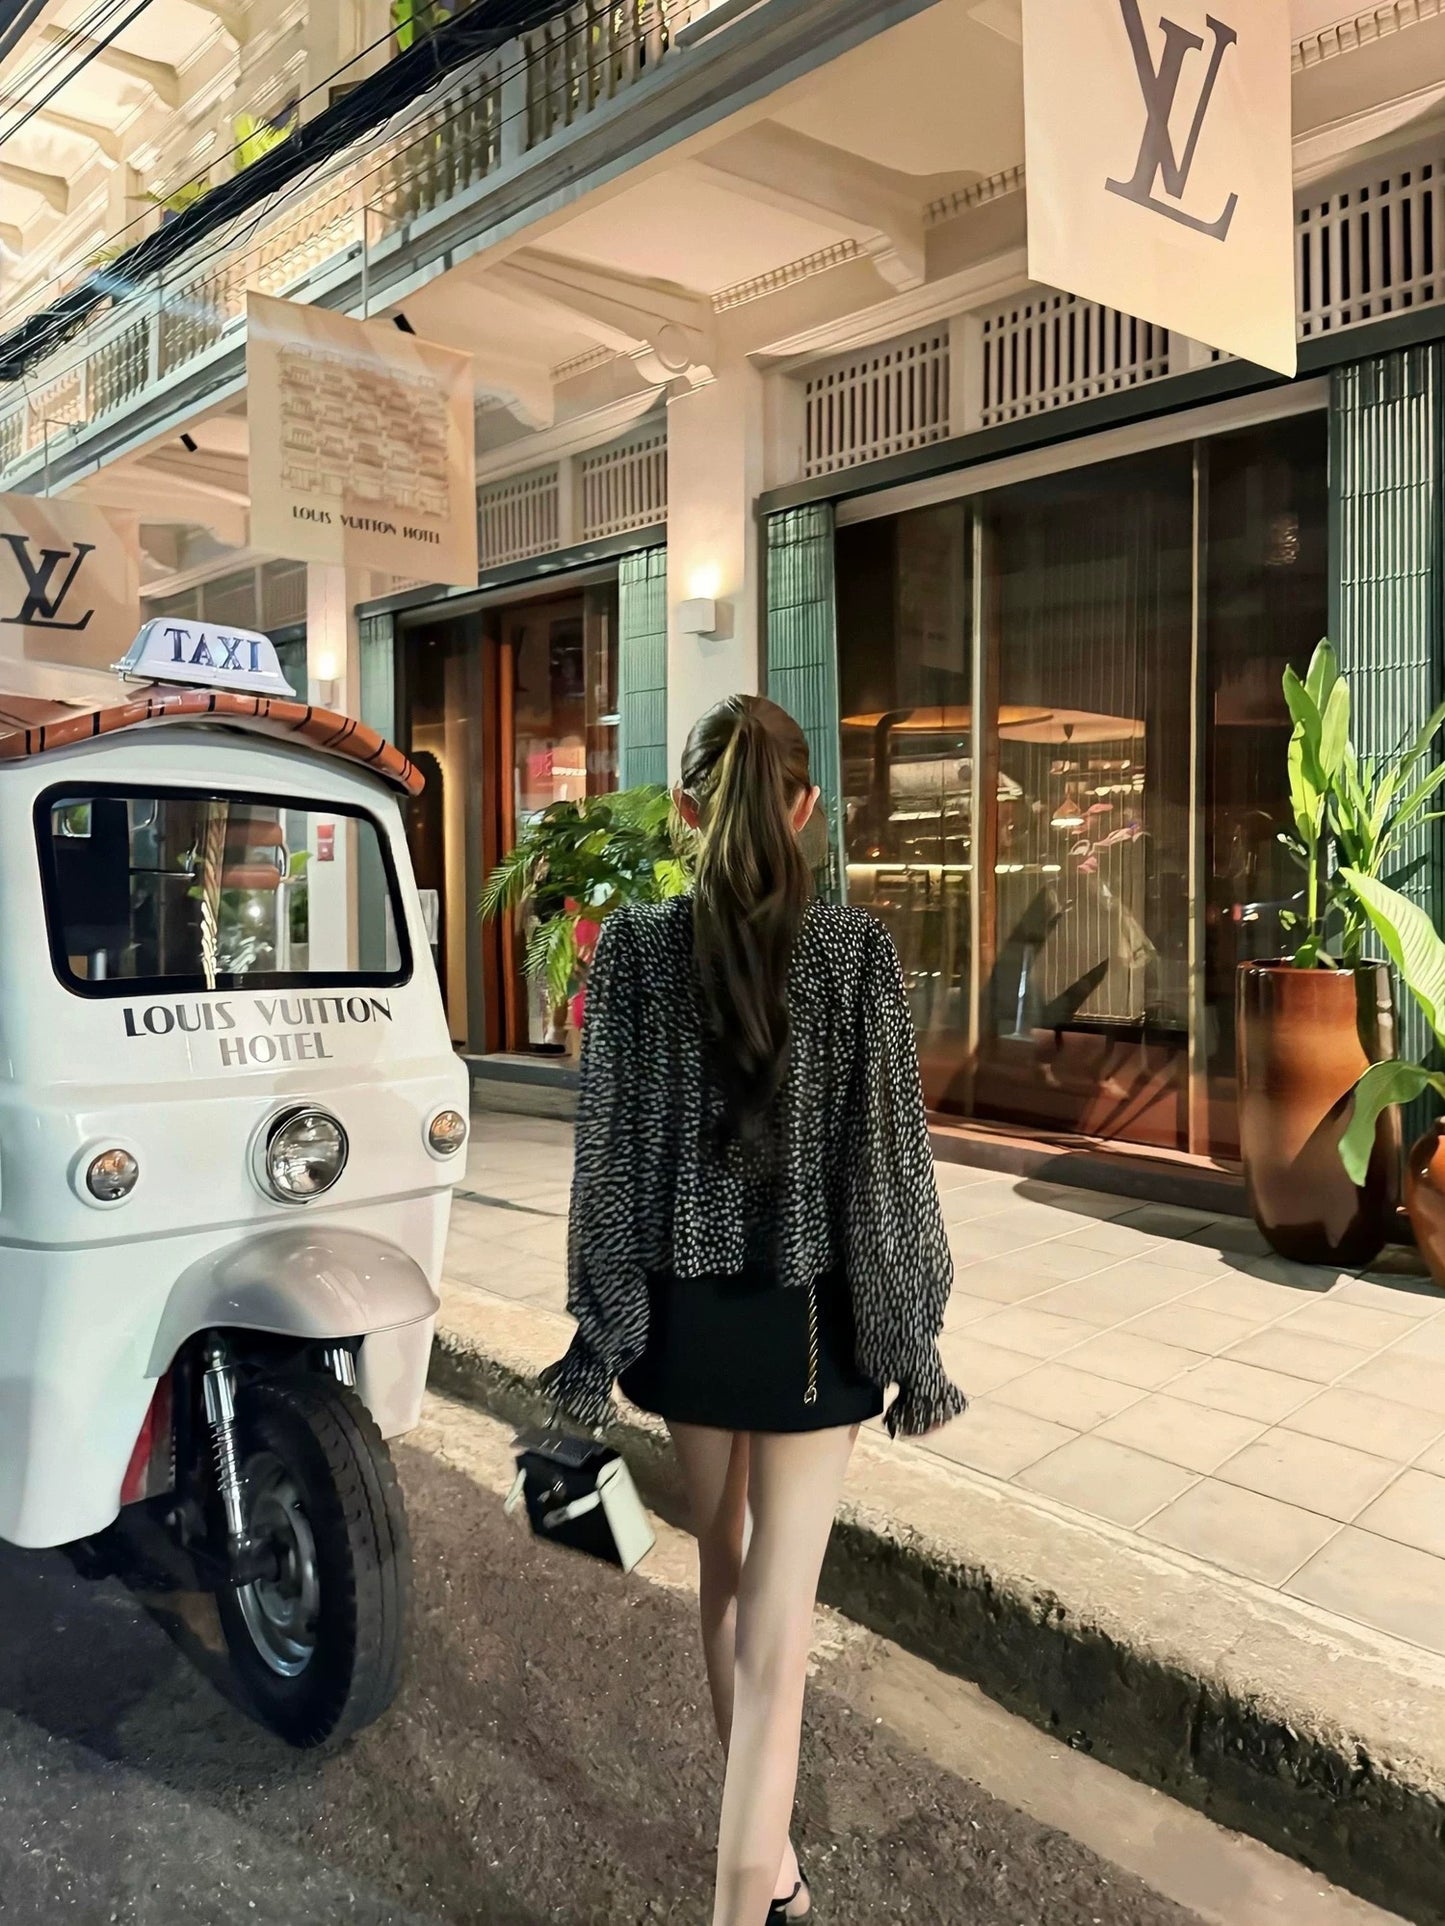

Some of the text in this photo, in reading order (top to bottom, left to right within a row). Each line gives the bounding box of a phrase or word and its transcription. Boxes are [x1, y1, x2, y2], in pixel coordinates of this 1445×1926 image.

[293, 505, 440, 544] LOUIS VUITTON HOTEL
[164, 628, 262, 672] TAXI
[123, 996, 393, 1037] LOUIS VUITTON
[219, 1032, 333, 1066] HOTEL
